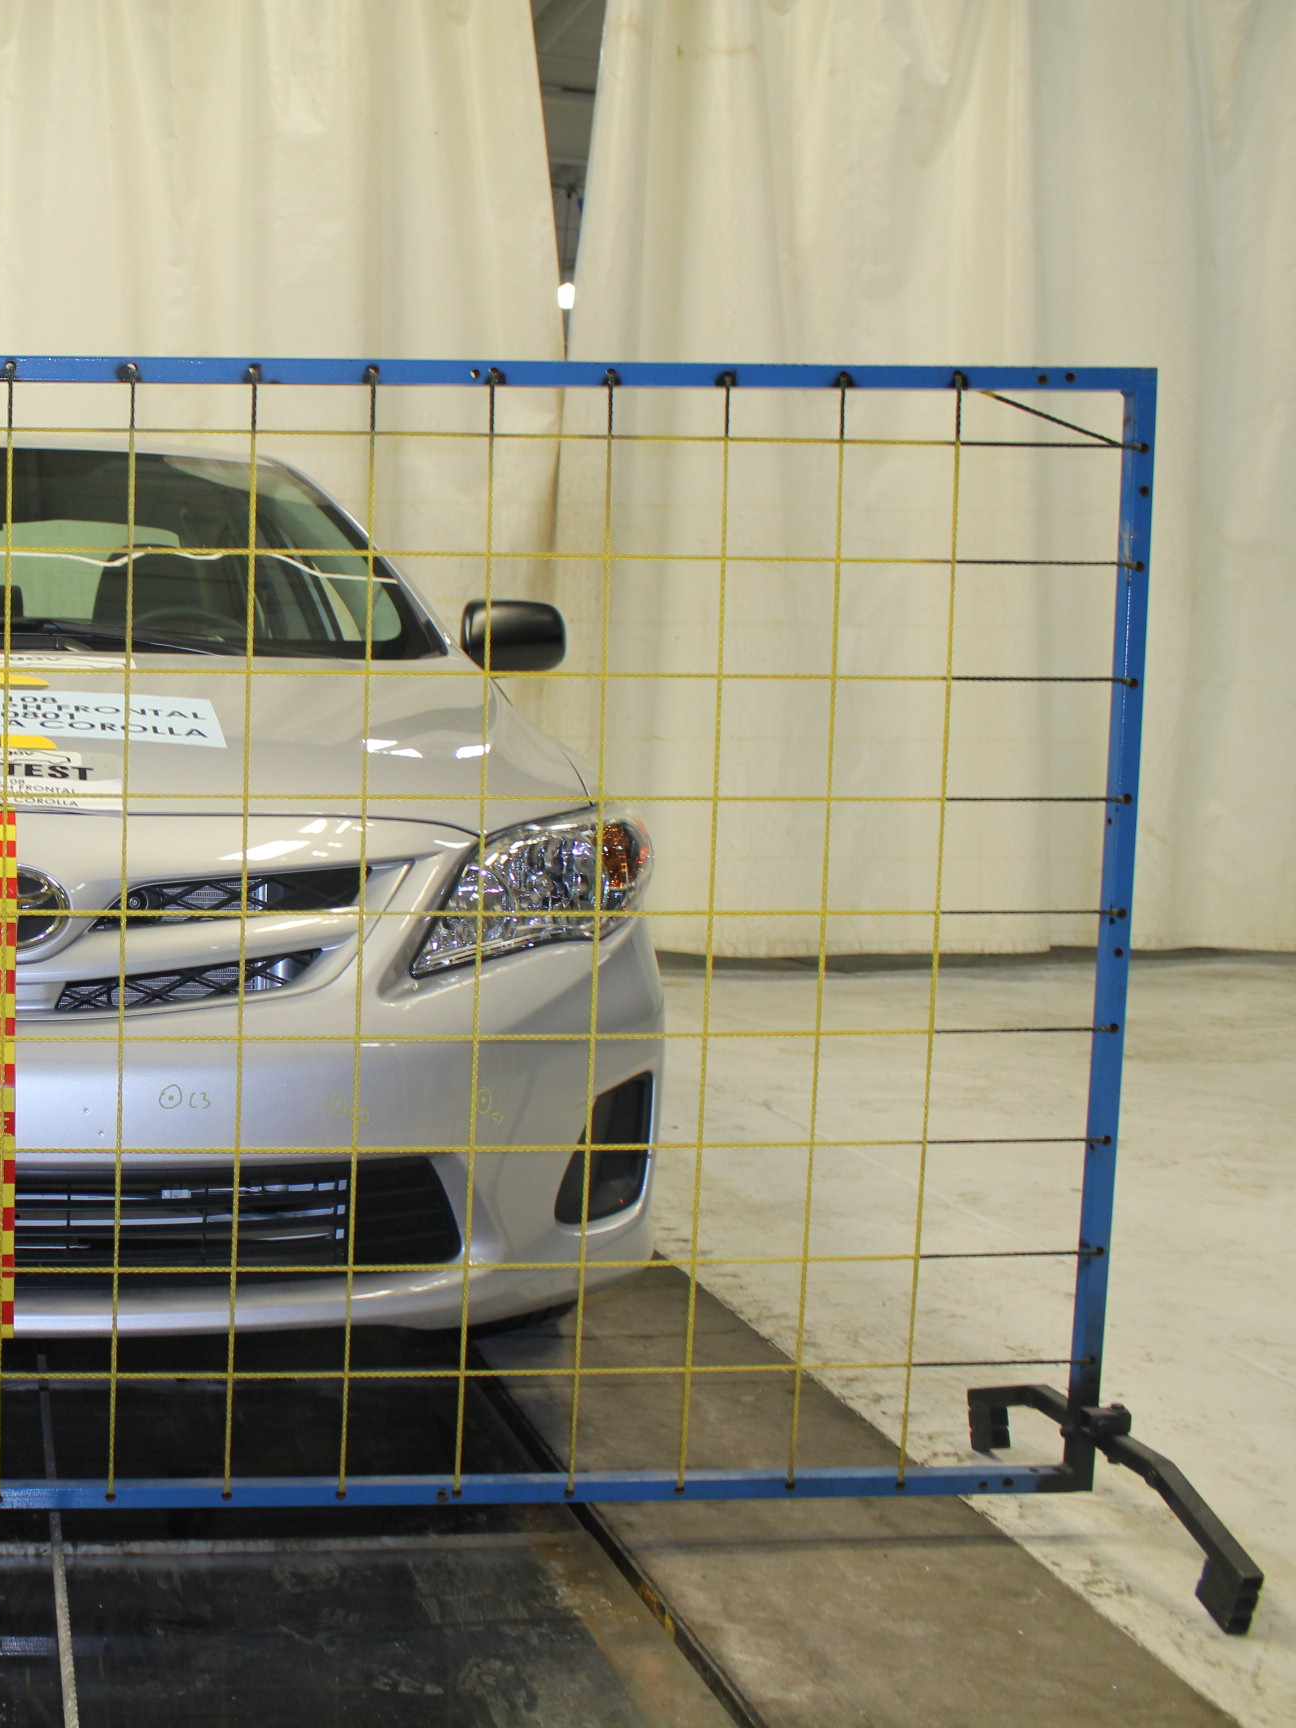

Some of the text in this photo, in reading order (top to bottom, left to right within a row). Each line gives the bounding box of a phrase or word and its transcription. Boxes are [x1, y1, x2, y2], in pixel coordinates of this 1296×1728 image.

[56, 704, 206, 720] FRONTAL
[39, 720, 208, 738] COROLLA
[14, 797, 79, 807] COROLLA
